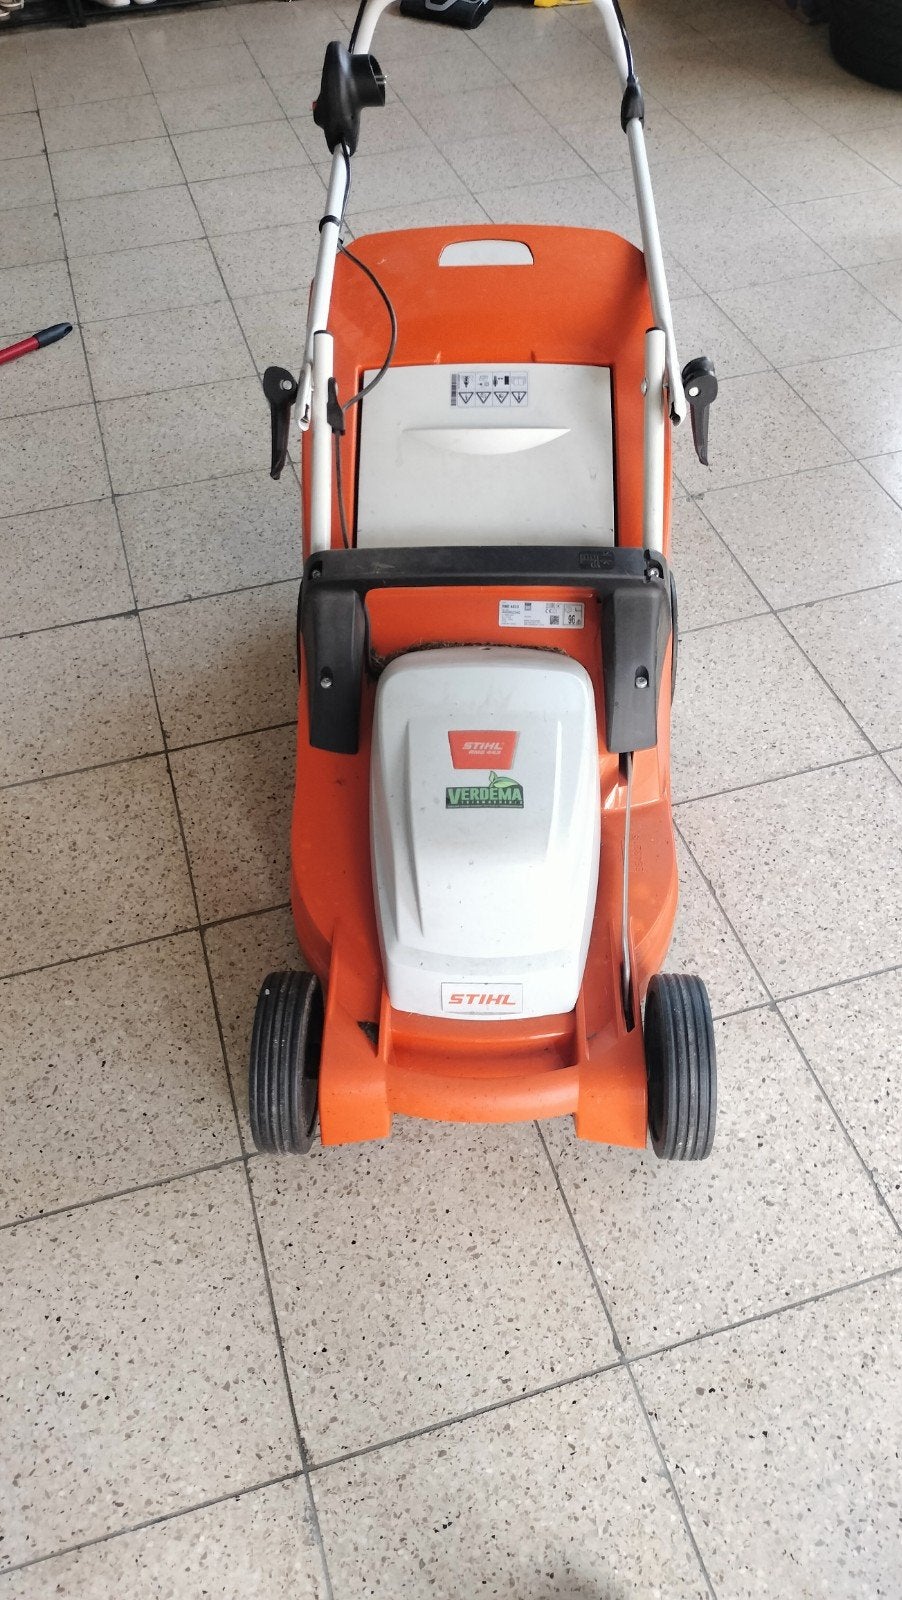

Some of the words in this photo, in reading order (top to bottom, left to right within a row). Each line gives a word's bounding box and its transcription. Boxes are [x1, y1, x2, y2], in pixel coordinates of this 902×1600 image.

[567, 614, 576, 625] 96
[462, 741, 504, 750] STIHL
[447, 788, 522, 804] VERDEMA
[448, 993, 516, 1005] STIHL
